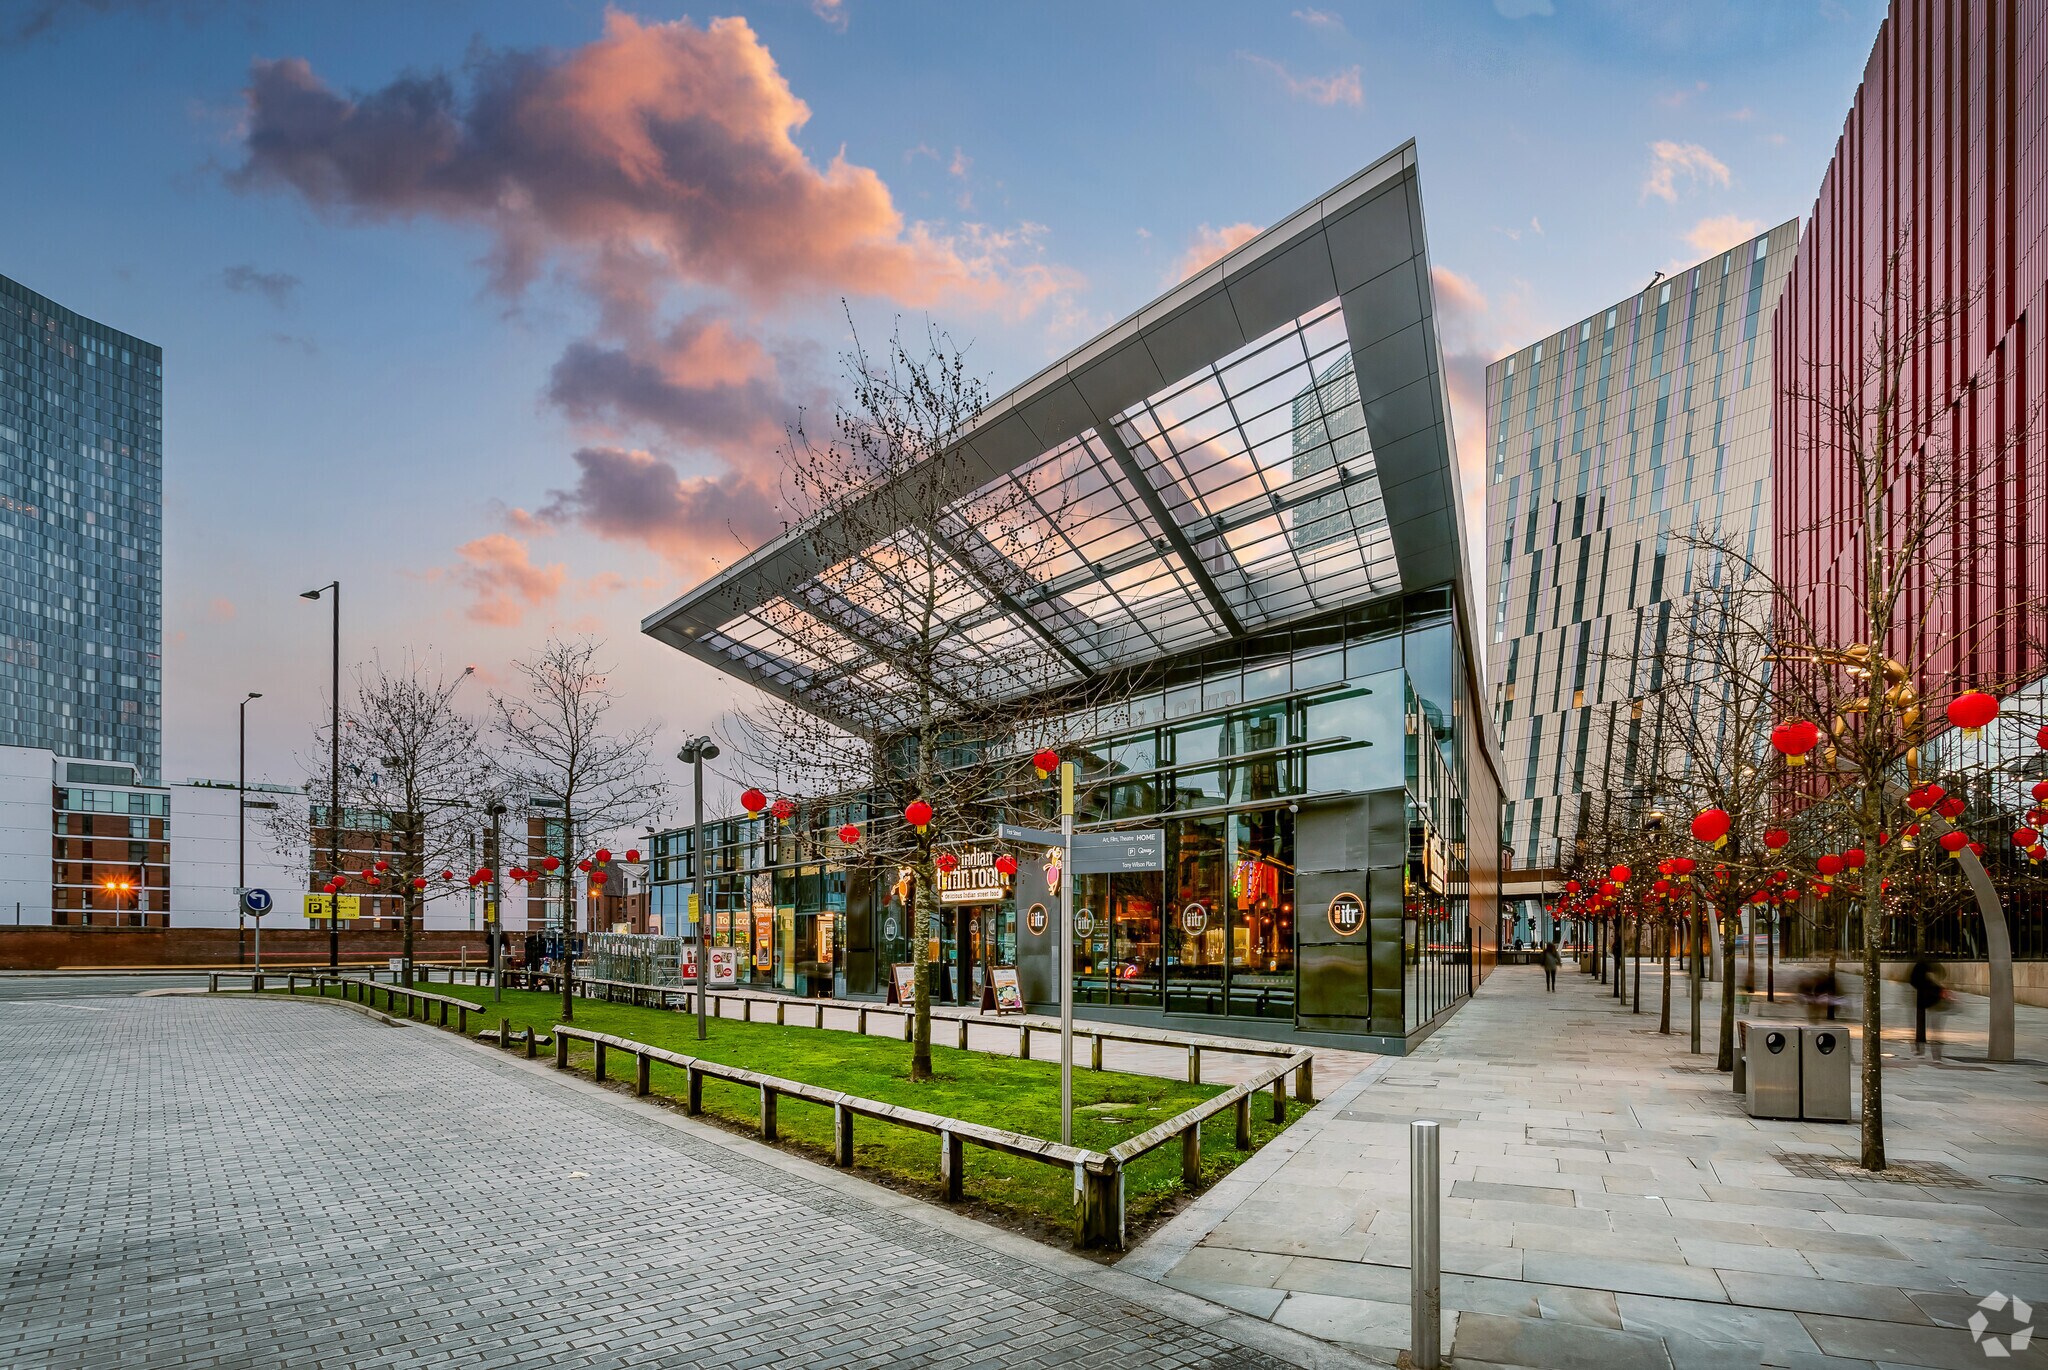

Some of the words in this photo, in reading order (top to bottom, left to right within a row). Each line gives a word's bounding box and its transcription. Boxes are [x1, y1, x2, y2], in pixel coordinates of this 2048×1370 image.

[1136, 833, 1156, 841] HOME
[961, 846, 993, 866] indian
[1035, 911, 1045, 926] itr
[1191, 911, 1203, 927] itr
[1341, 903, 1359, 924] itr
[1081, 916, 1091, 929] itr
